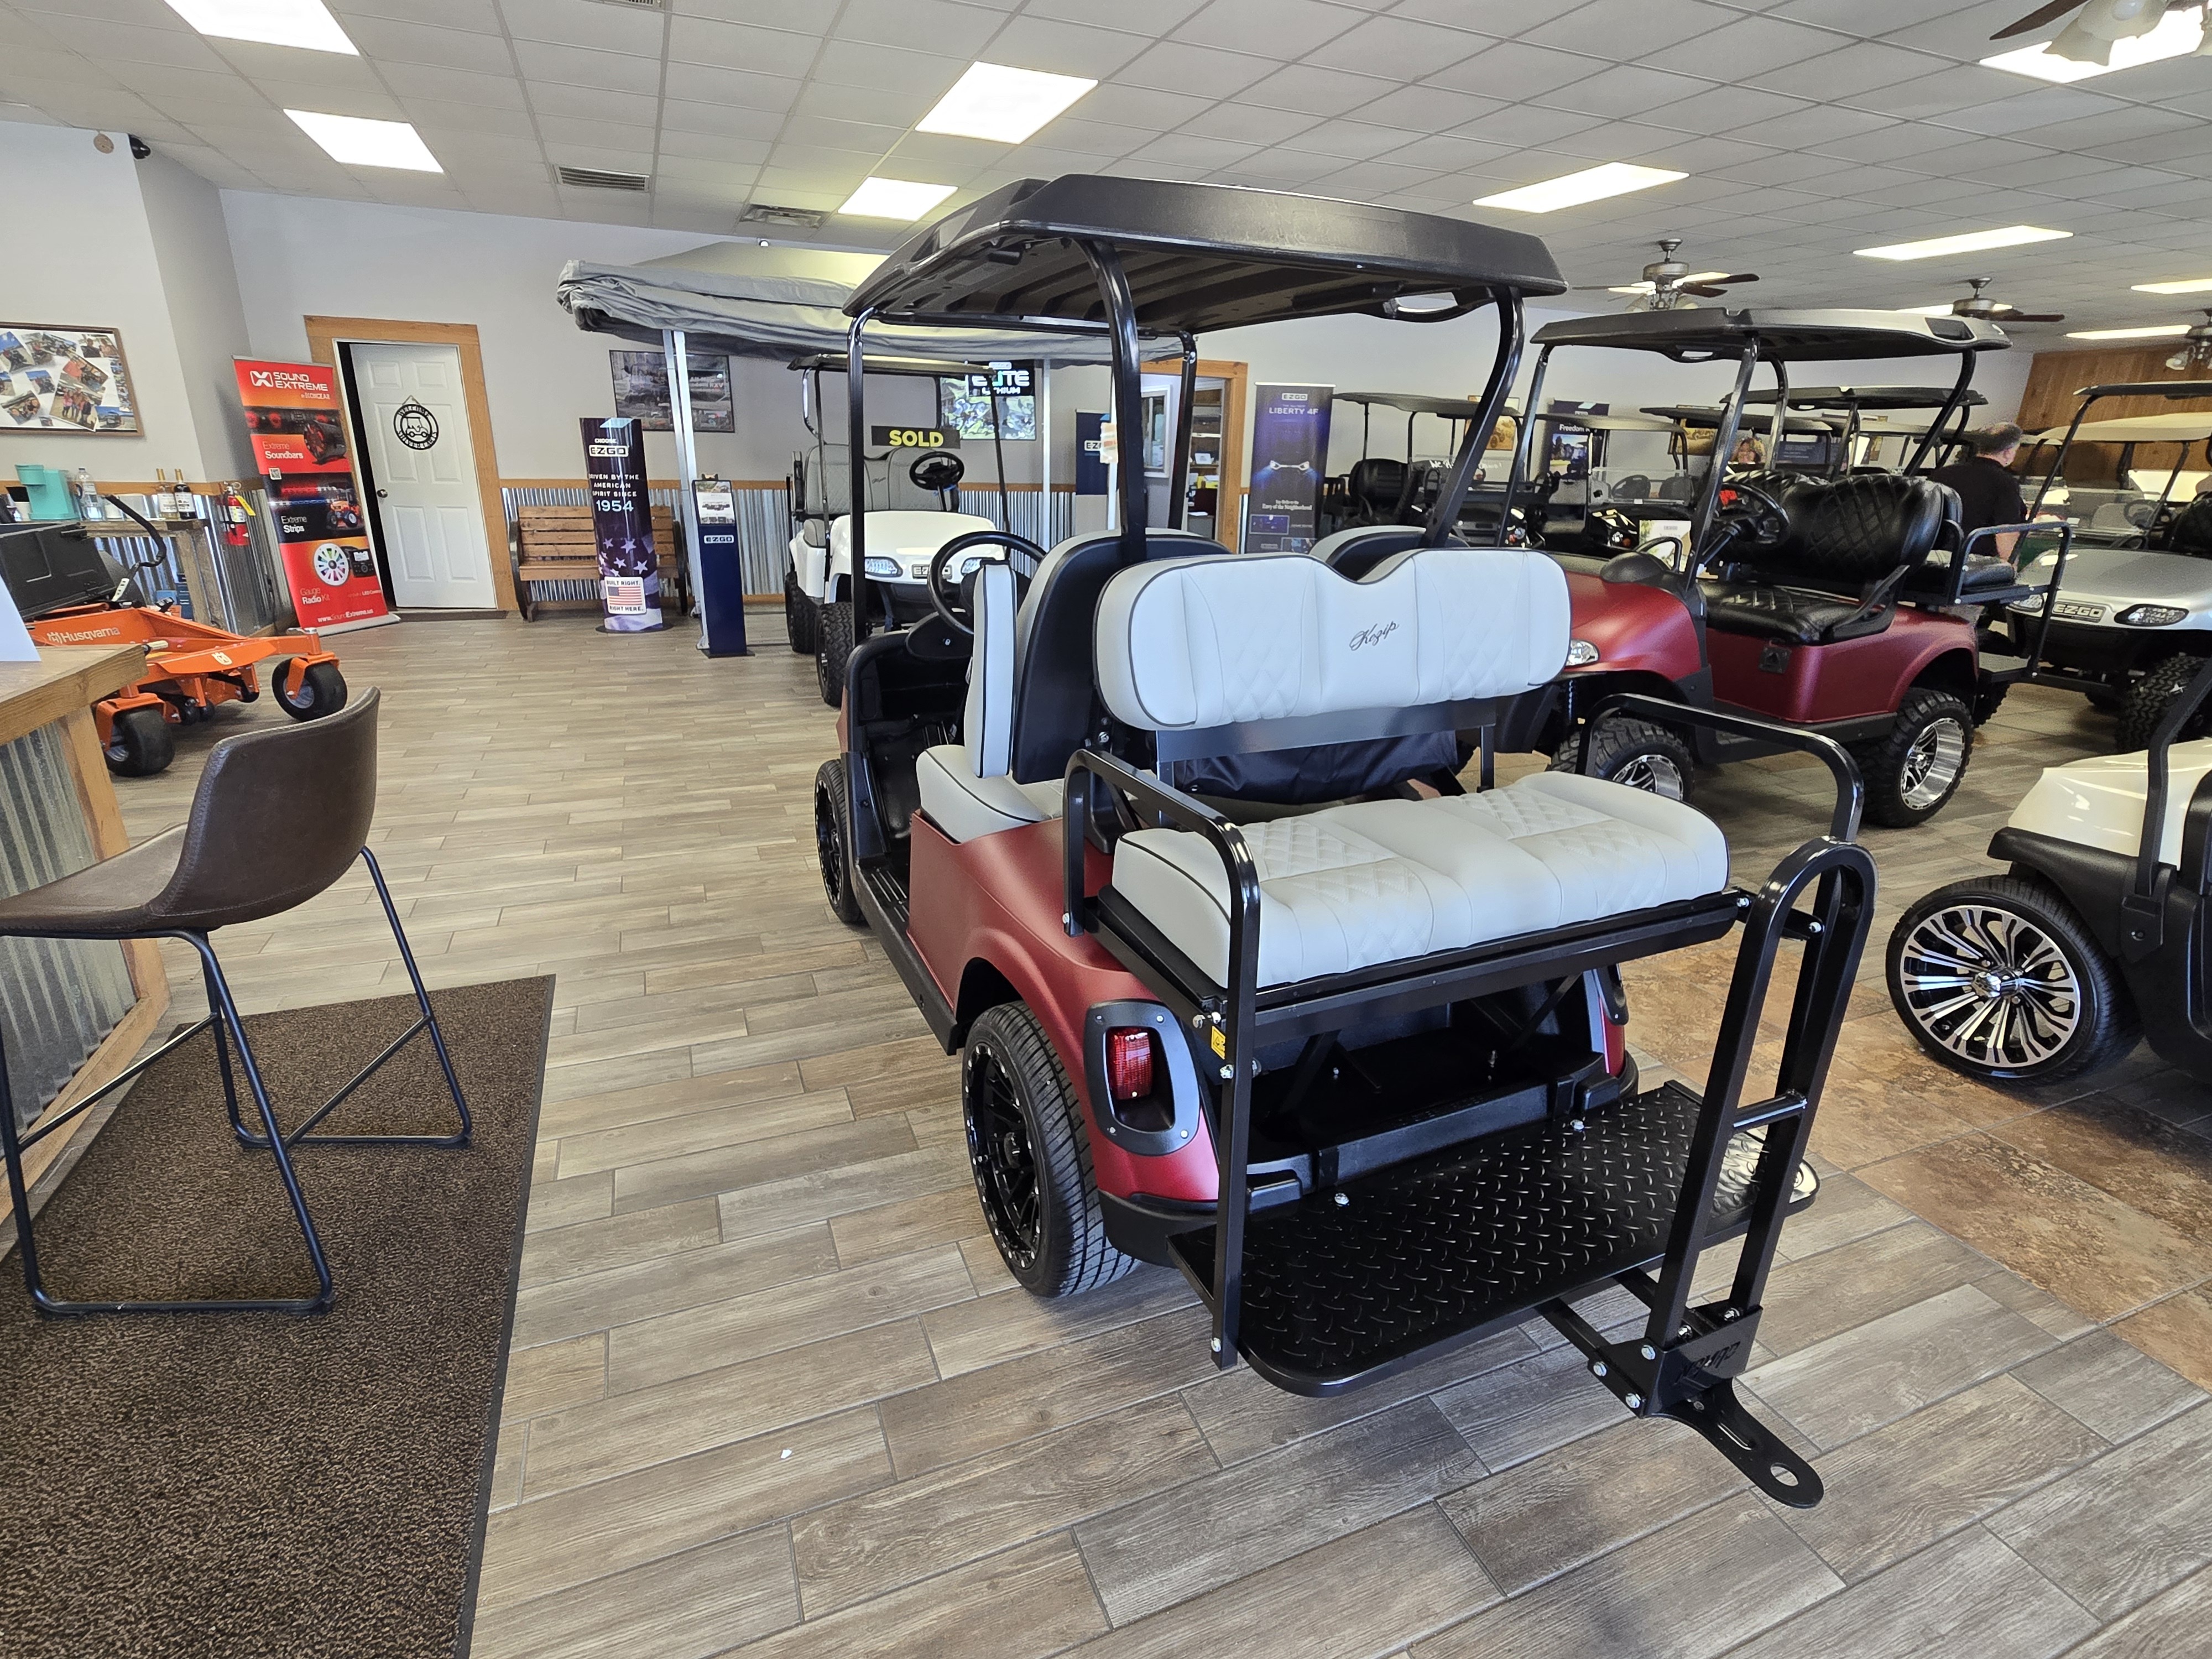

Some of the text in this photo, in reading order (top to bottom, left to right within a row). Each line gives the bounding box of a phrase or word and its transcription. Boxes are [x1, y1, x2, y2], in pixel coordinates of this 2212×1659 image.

[273, 372, 309, 382] SOUND
[275, 380, 328, 391] EXTREME
[889, 429, 944, 447] SOLD
[262, 441, 290, 450] Extreme
[265, 451, 304, 459] Soundbars
[590, 446, 626, 455] EZGO
[596, 499, 634, 512] 1954
[281, 515, 307, 524] Extreme
[283, 524, 305, 533] Strips
[914, 567, 951, 575] EZO
[300, 588, 321, 596] Gauge
[302, 596, 321, 604] Radio
[2053, 604, 2103, 618] EZGO
[60, 627, 120, 642] Husqvarna
